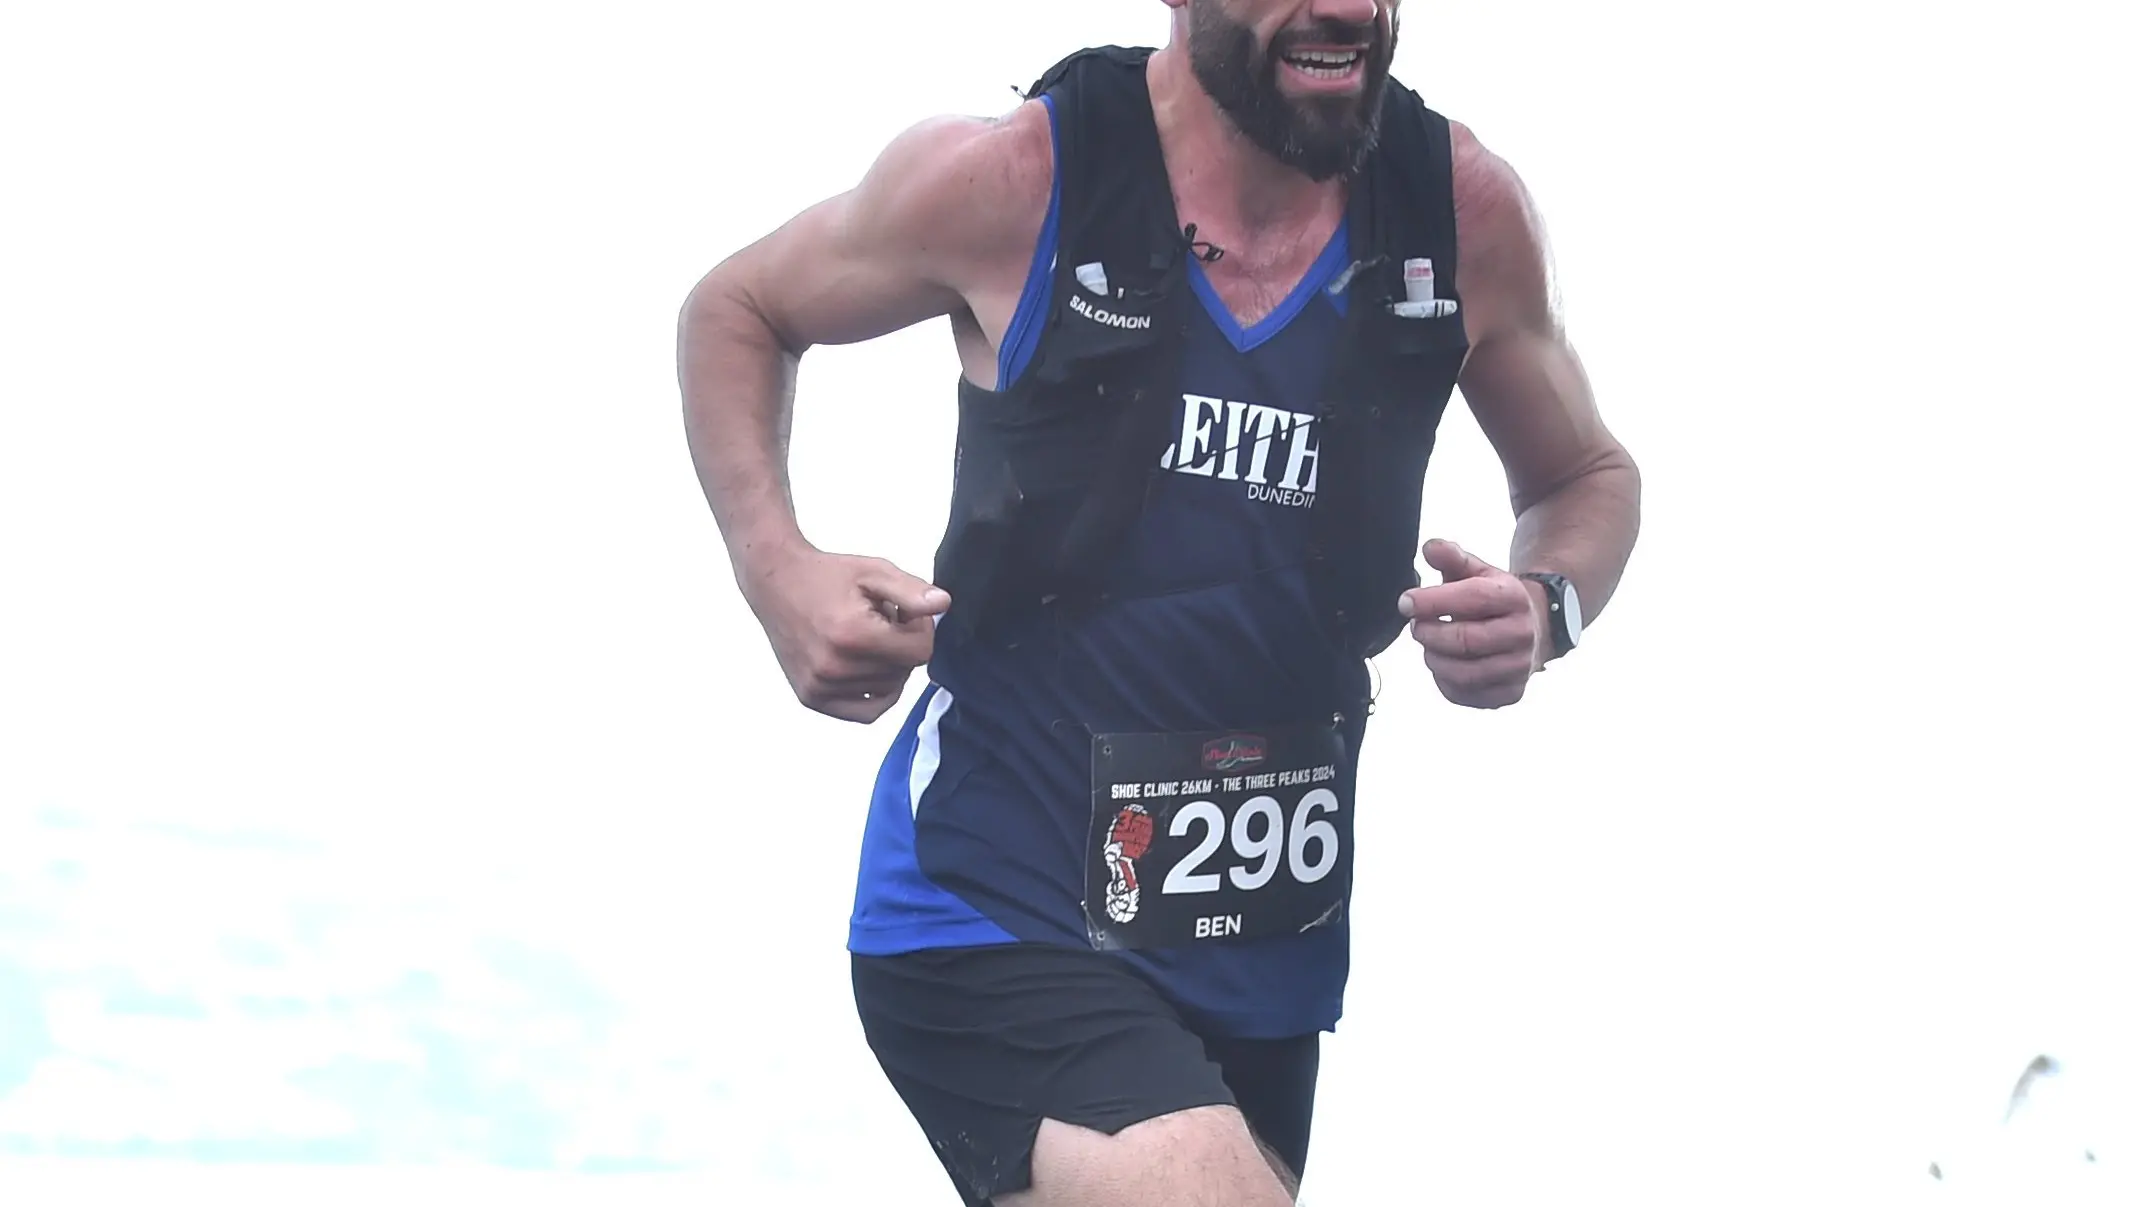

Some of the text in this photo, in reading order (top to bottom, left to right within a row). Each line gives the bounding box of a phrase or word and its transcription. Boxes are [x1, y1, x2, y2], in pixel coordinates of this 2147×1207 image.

[1069, 294, 1151, 329] SALOMON
[1111, 783, 1141, 799] SHOE
[1143, 782, 1180, 798] CLINIC
[1180, 779, 1213, 796] 26KM
[1222, 776, 1242, 792] THE
[1245, 773, 1277, 791] THREE
[1278, 768, 1311, 787] PEAKS
[1312, 764, 1336, 782] 2024
[1161, 788, 1340, 895] 296
[1195, 913, 1243, 939] BEN
